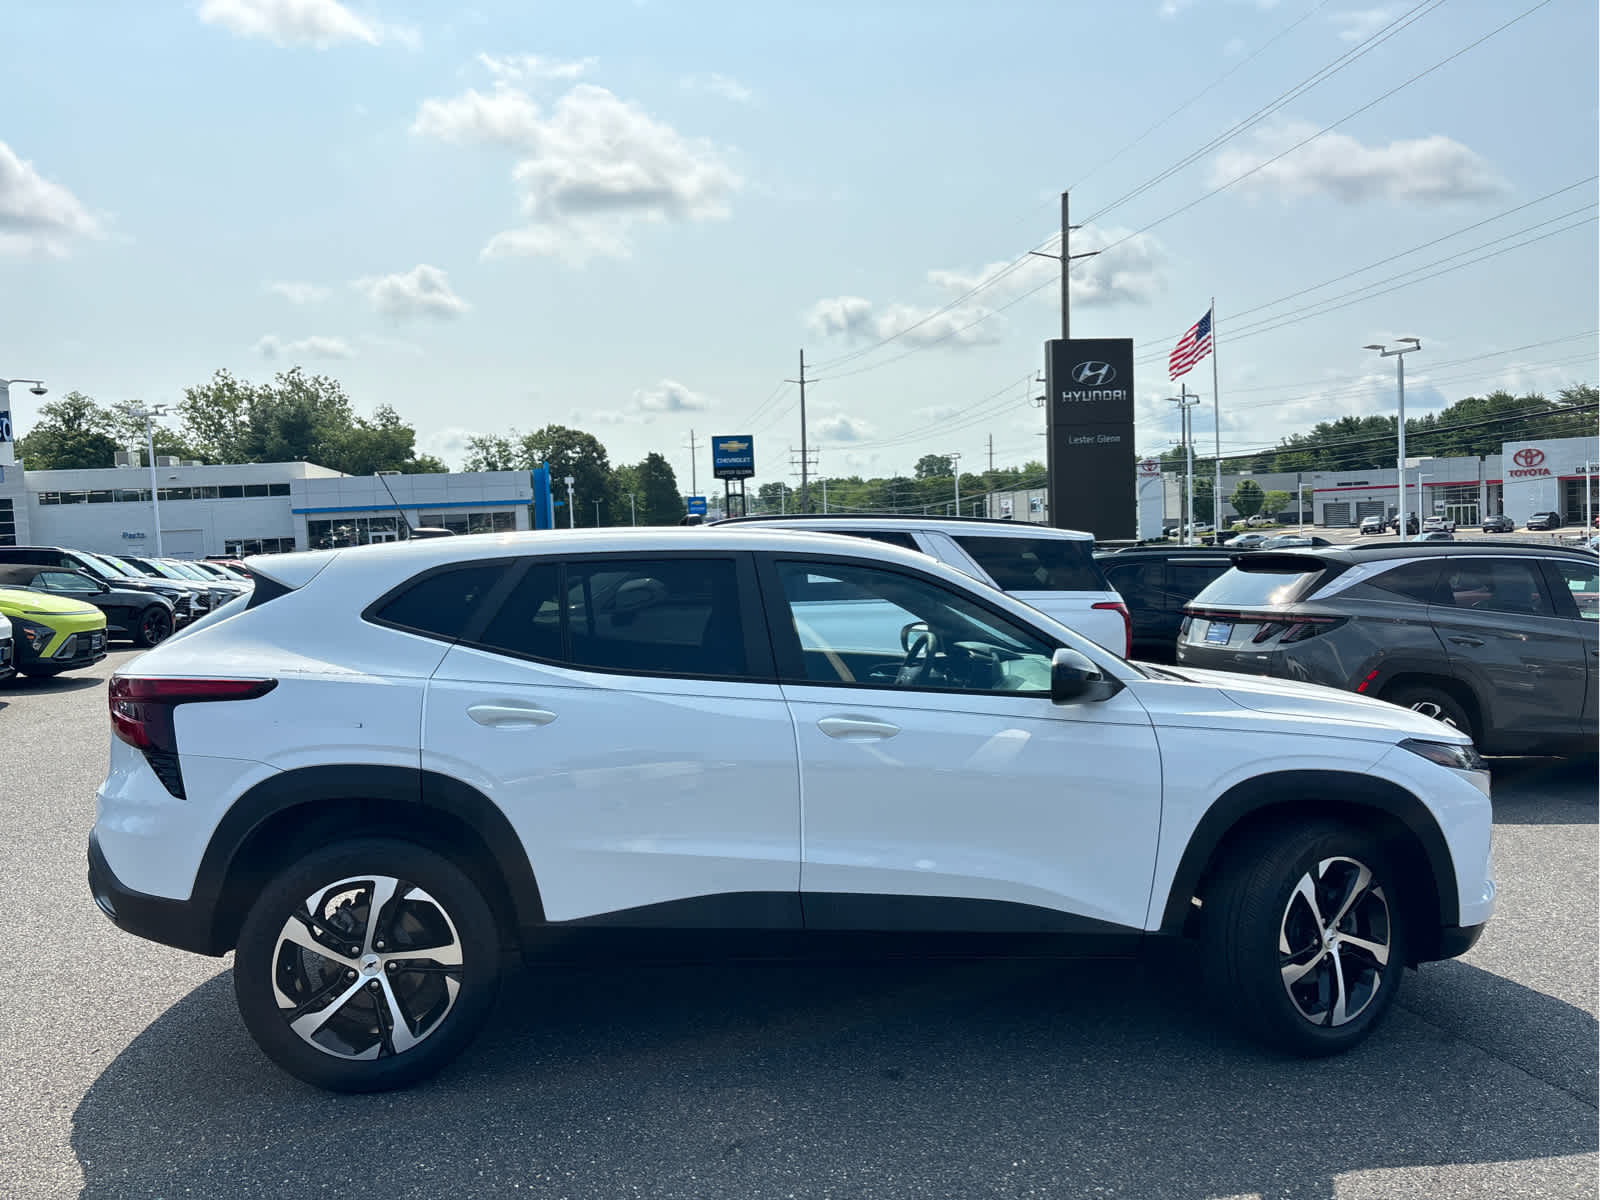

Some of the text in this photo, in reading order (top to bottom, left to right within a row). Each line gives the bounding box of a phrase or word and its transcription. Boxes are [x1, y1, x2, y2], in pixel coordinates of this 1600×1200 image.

[1062, 390, 1126, 402] HYUNDAI
[1068, 434, 1121, 445] Lester Glenn
[1508, 467, 1551, 478] TOYOTA
